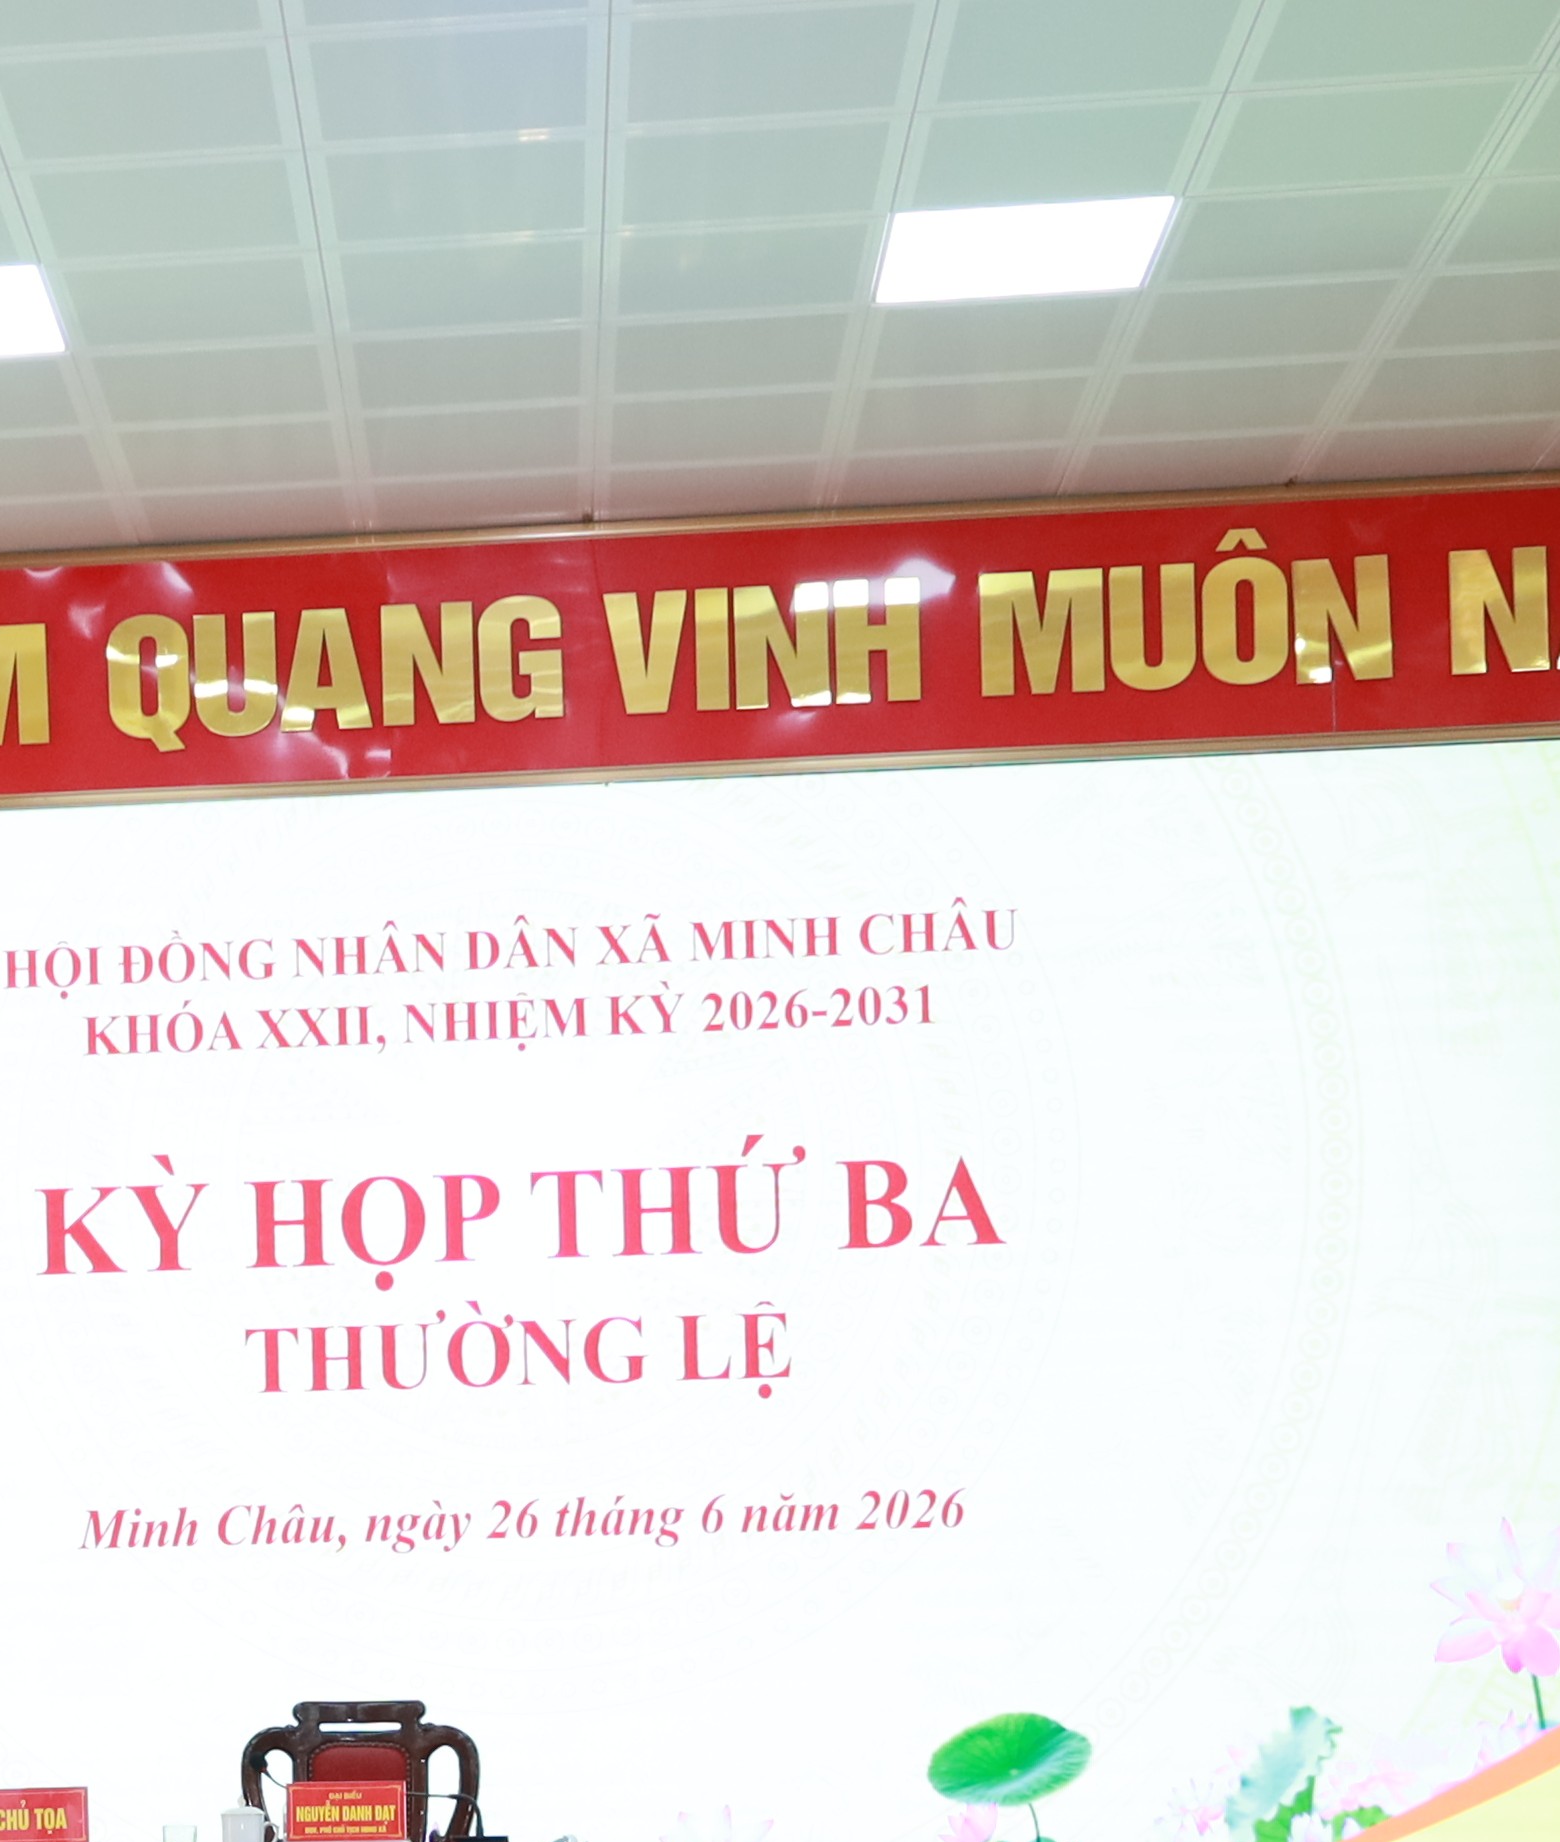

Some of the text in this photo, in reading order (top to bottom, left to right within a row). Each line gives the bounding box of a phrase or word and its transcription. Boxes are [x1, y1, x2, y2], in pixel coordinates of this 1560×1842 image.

[106, 596, 565, 753] QUANG
[603, 576, 922, 715] VINH
[977, 528, 1395, 698] MUÔN
[4, 897, 1018, 999] HỘI ĐỒNG NHÂN DÂN XÃ MINH CHÂU
[85, 981, 935, 1056] KHÓA XXII, NHIỆM KỲ 2026-2031
[38, 1134, 1006, 1292] KỲ HỌP THỨ BA
[245, 1300, 791, 1399] THƯỜNG LỆ
[78, 1489, 964, 1552] Minh Châu, ngày 26 tháng 6 năm 2026
[34, 1808, 68, 1835] TỌA
[295, 1800, 397, 1825] NGUYỄN DANH ĐẠT
